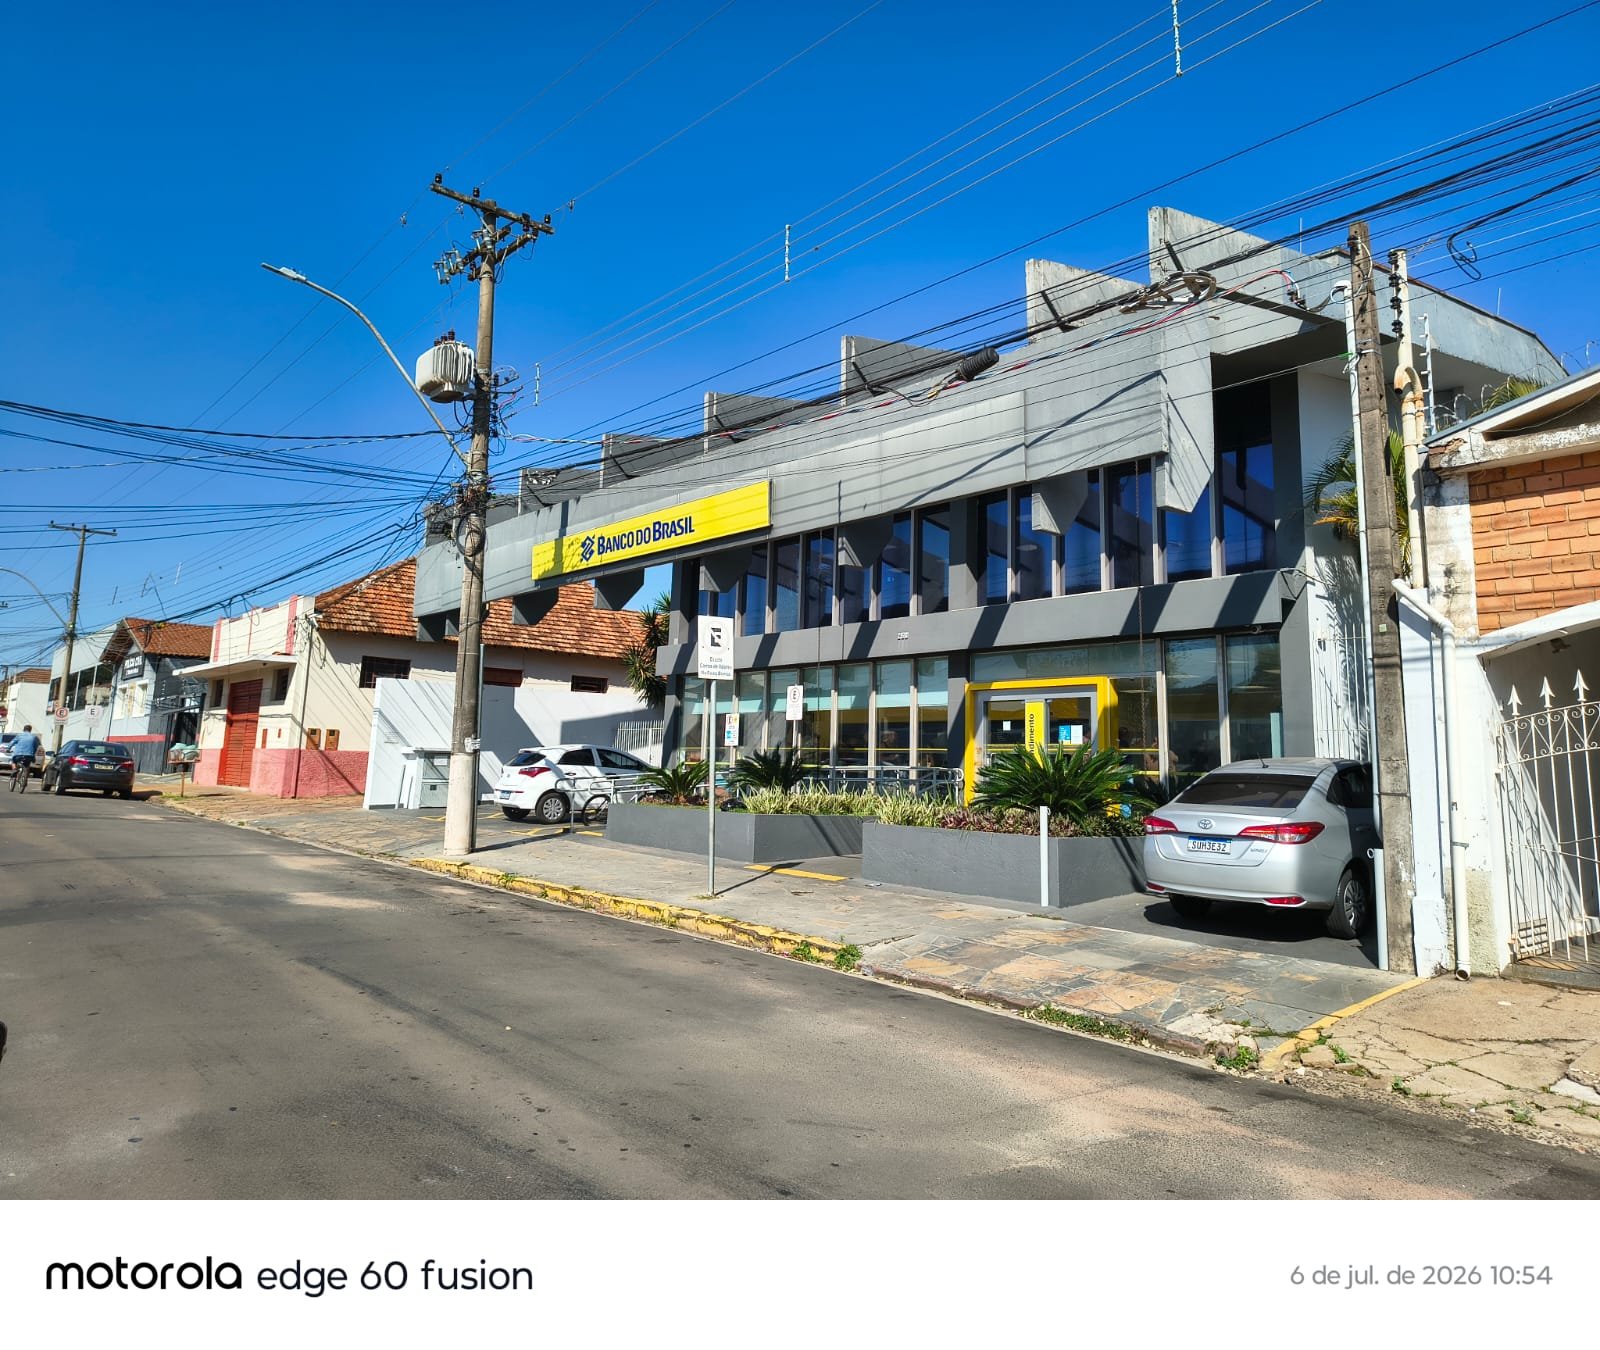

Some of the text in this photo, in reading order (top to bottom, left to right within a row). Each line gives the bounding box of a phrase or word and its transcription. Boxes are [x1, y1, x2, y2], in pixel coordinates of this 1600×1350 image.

[598, 516, 695, 555] BANCO DO BRASIL
[90, 708, 96, 716] E
[1191, 840, 1227, 852] SUH3E32
